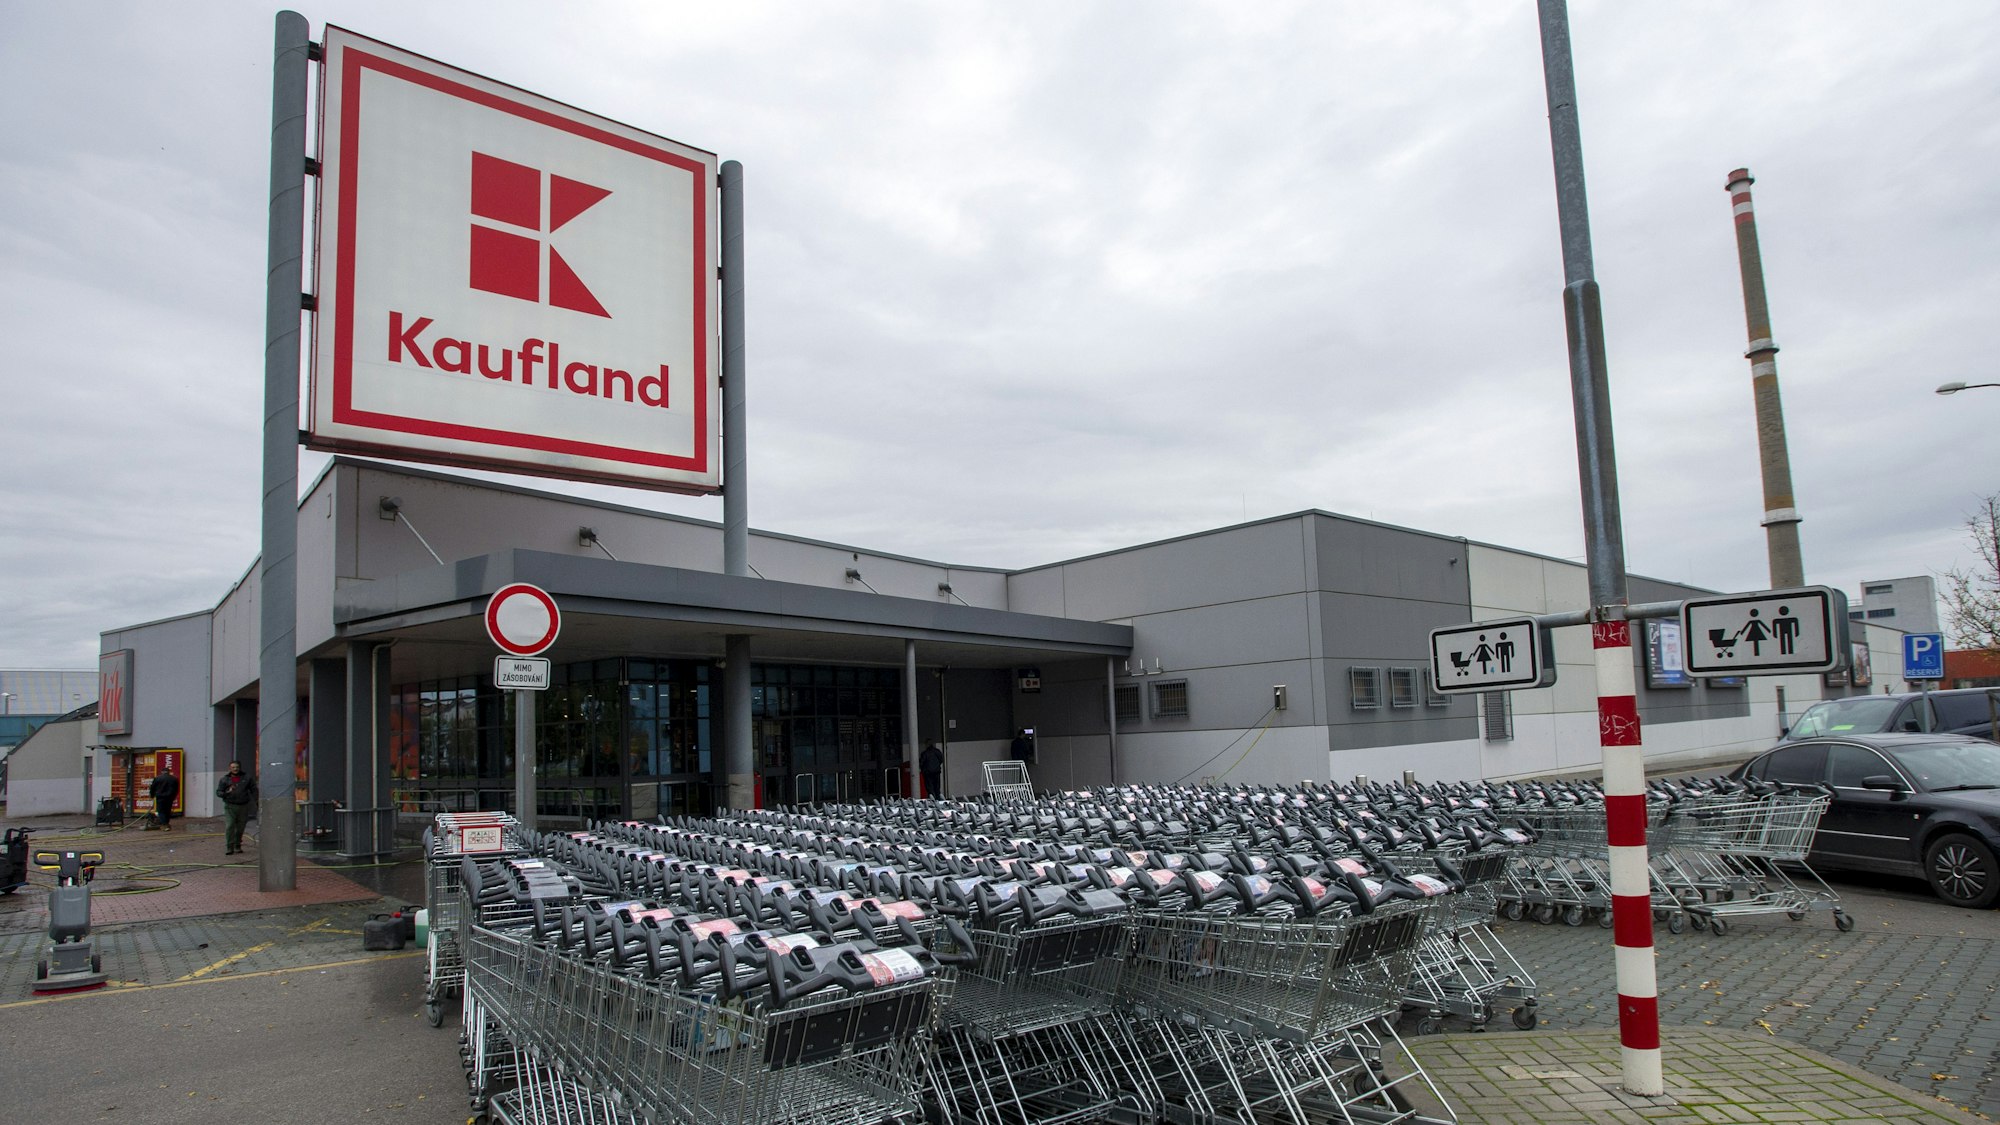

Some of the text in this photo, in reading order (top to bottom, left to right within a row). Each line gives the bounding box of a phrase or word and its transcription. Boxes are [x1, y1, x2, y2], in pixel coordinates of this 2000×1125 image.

[388, 311, 669, 409] Kaufland
[1912, 637, 1932, 661] P
[514, 663, 532, 672] MIMO
[502, 672, 543, 683] ZÁSOBOVÁNÍ
